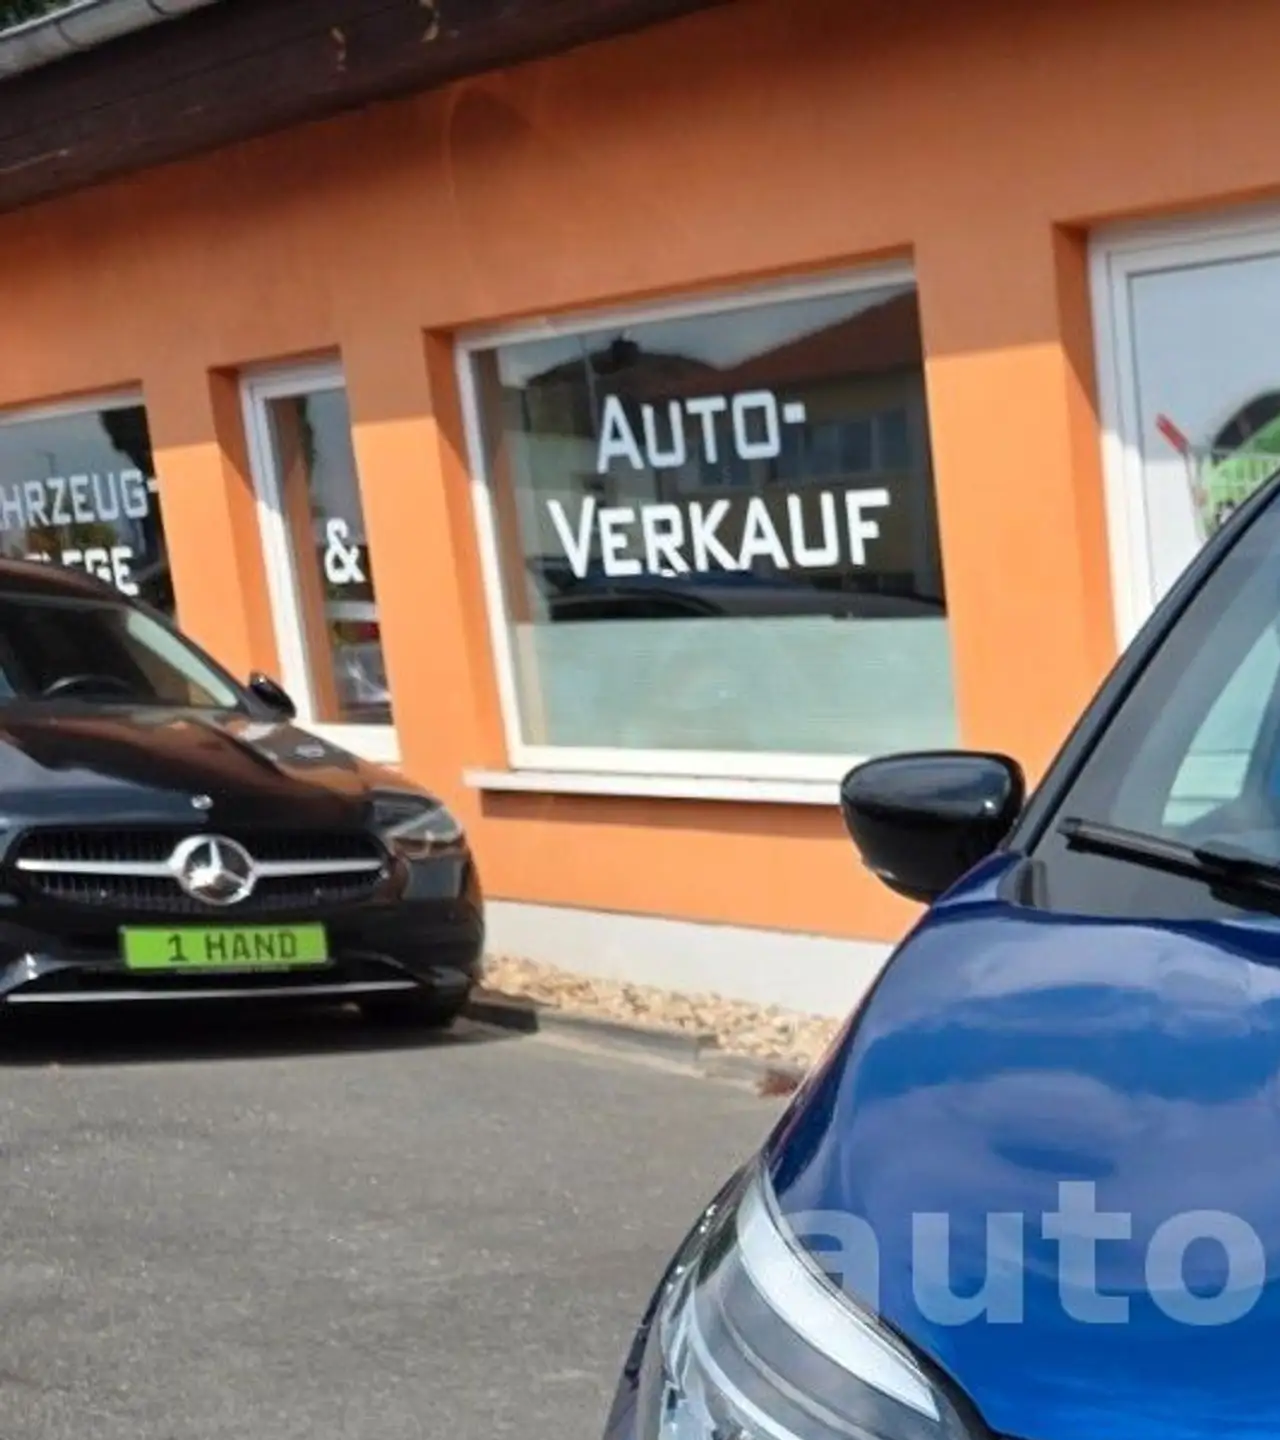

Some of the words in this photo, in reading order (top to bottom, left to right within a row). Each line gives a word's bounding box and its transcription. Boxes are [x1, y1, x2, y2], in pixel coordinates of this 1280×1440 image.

[598, 391, 806, 474] AUTO-
[0, 469, 159, 530] HRZEUG-
[324, 518, 366, 584] &
[547, 489, 891, 578] VERKAUF
[168, 934, 187, 961] 1
[205, 932, 298, 961] HAND
